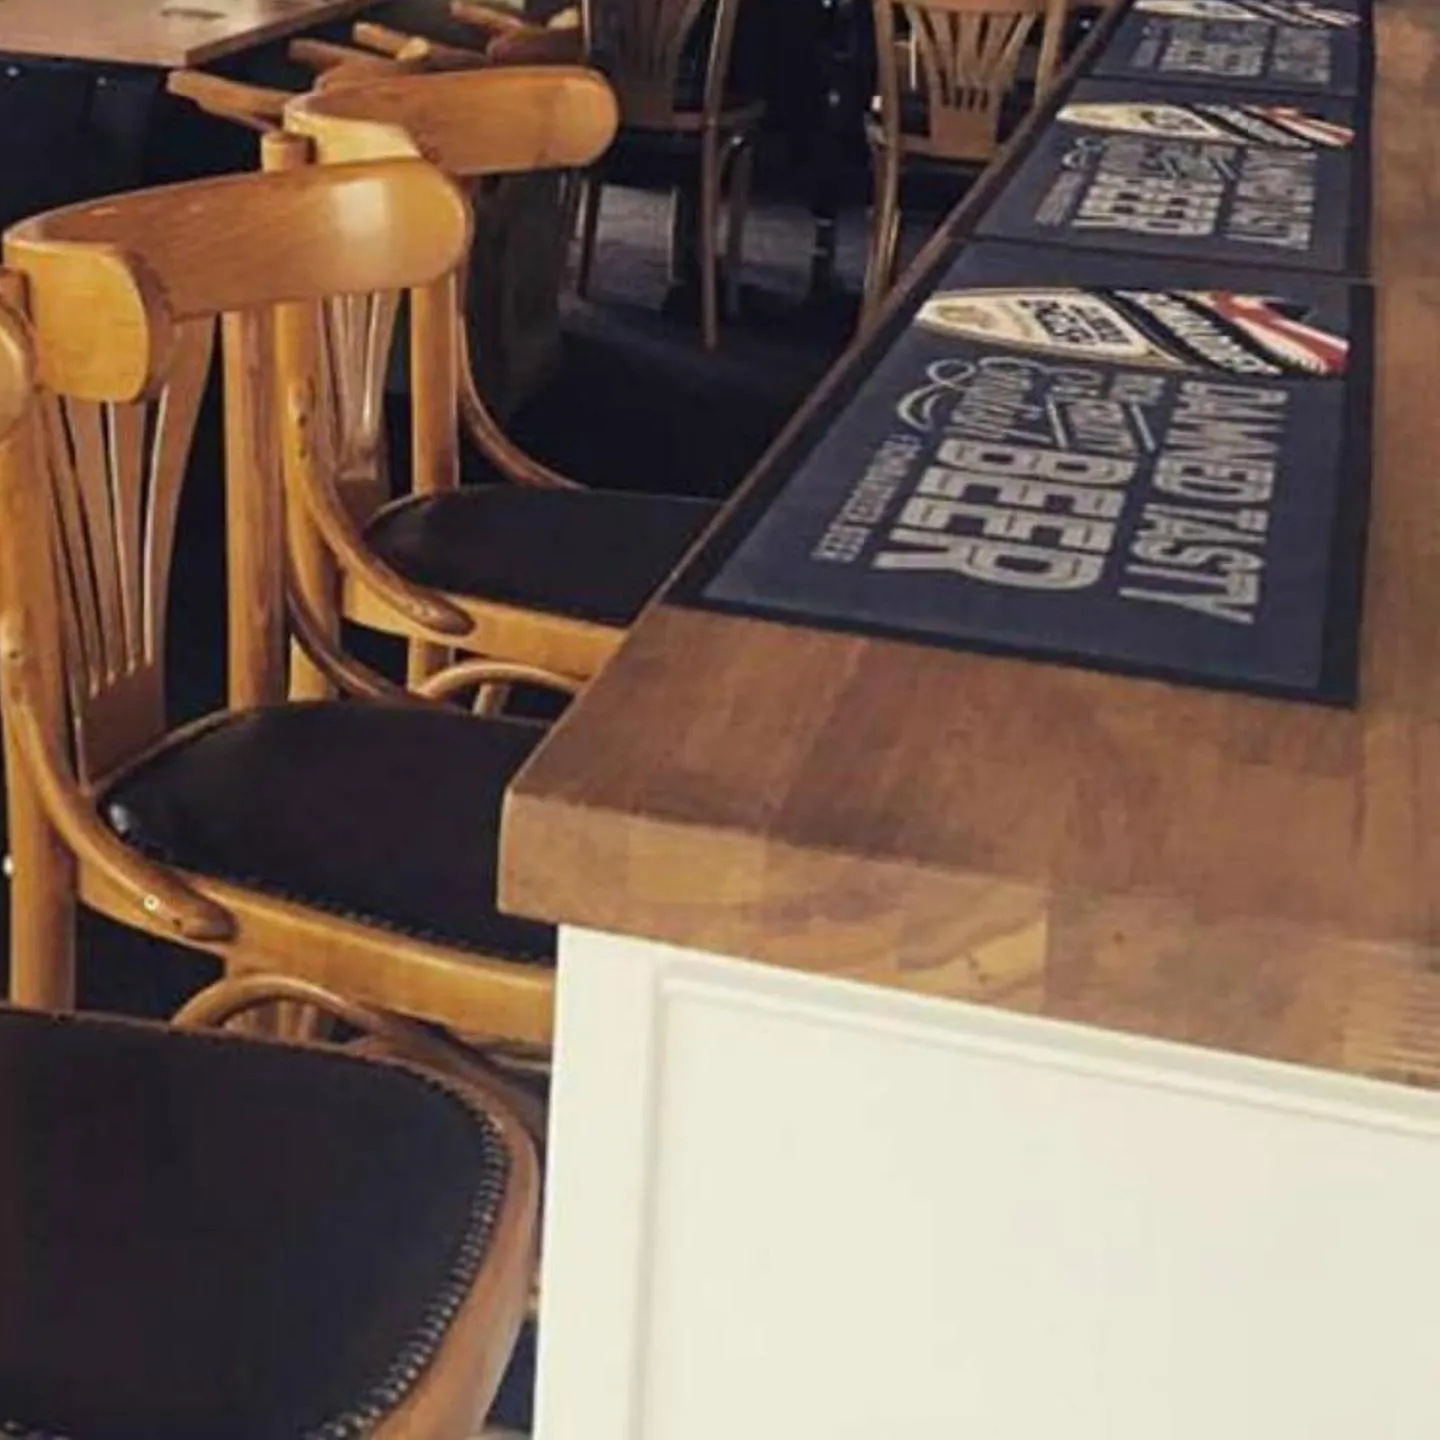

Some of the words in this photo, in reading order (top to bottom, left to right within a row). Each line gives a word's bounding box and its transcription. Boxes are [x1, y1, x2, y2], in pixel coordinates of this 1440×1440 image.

[1152, 380, 1289, 502] DAMNED
[871, 437, 1139, 590] BEER
[1118, 503, 1269, 625] TASTY
